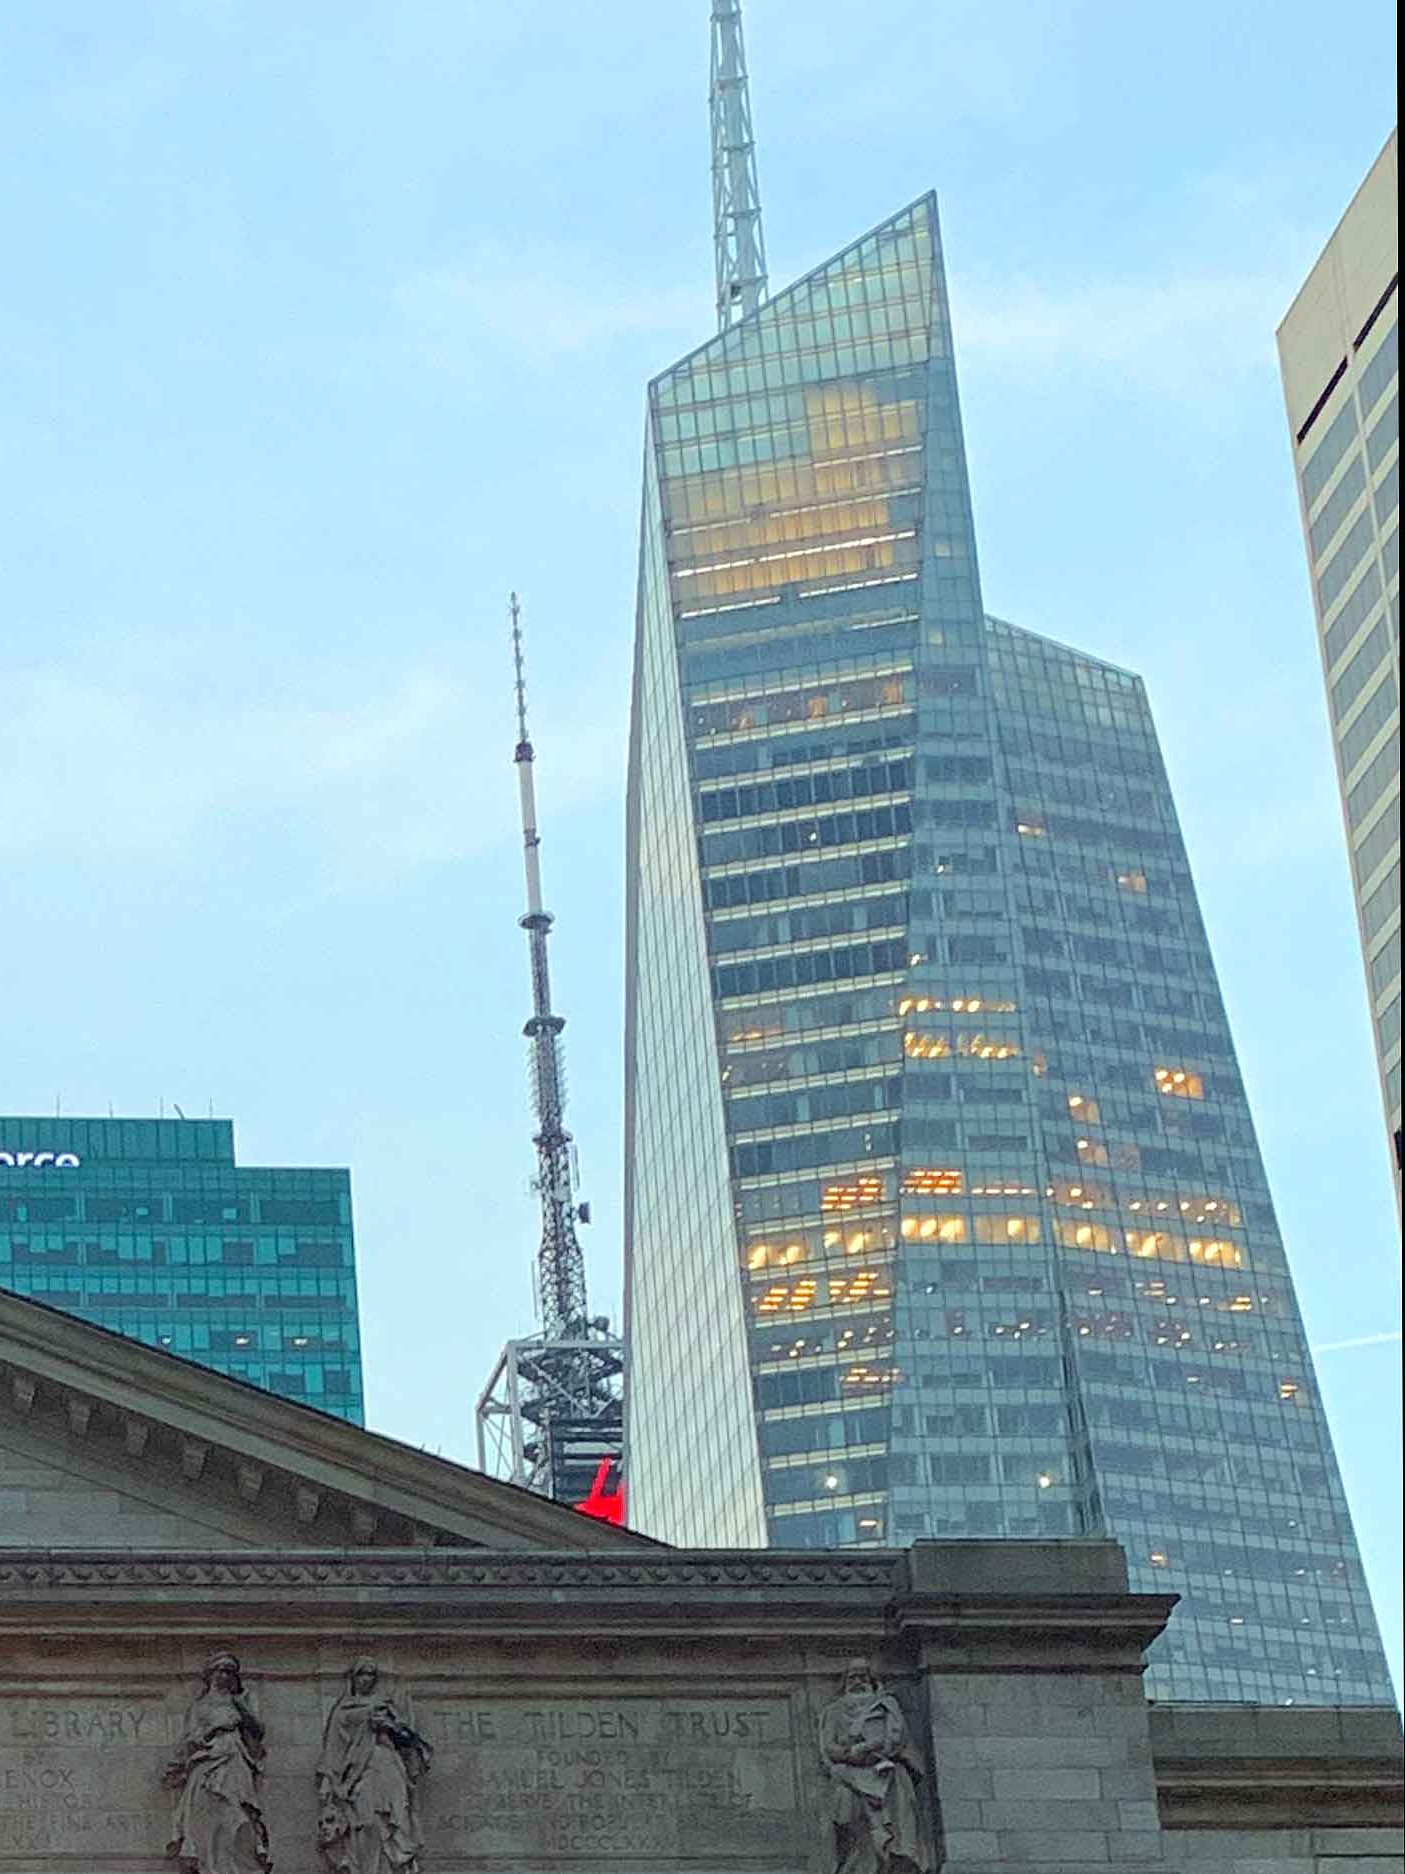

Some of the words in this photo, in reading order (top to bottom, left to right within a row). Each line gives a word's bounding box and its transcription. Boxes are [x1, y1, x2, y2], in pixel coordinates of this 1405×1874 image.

[13, 1711, 148, 1738] LIBRARY
[434, 1711, 496, 1739] THE
[523, 1711, 640, 1739] TILDEN
[666, 1711, 771, 1739] TRUST
[577, 1770, 651, 1790] JONES
